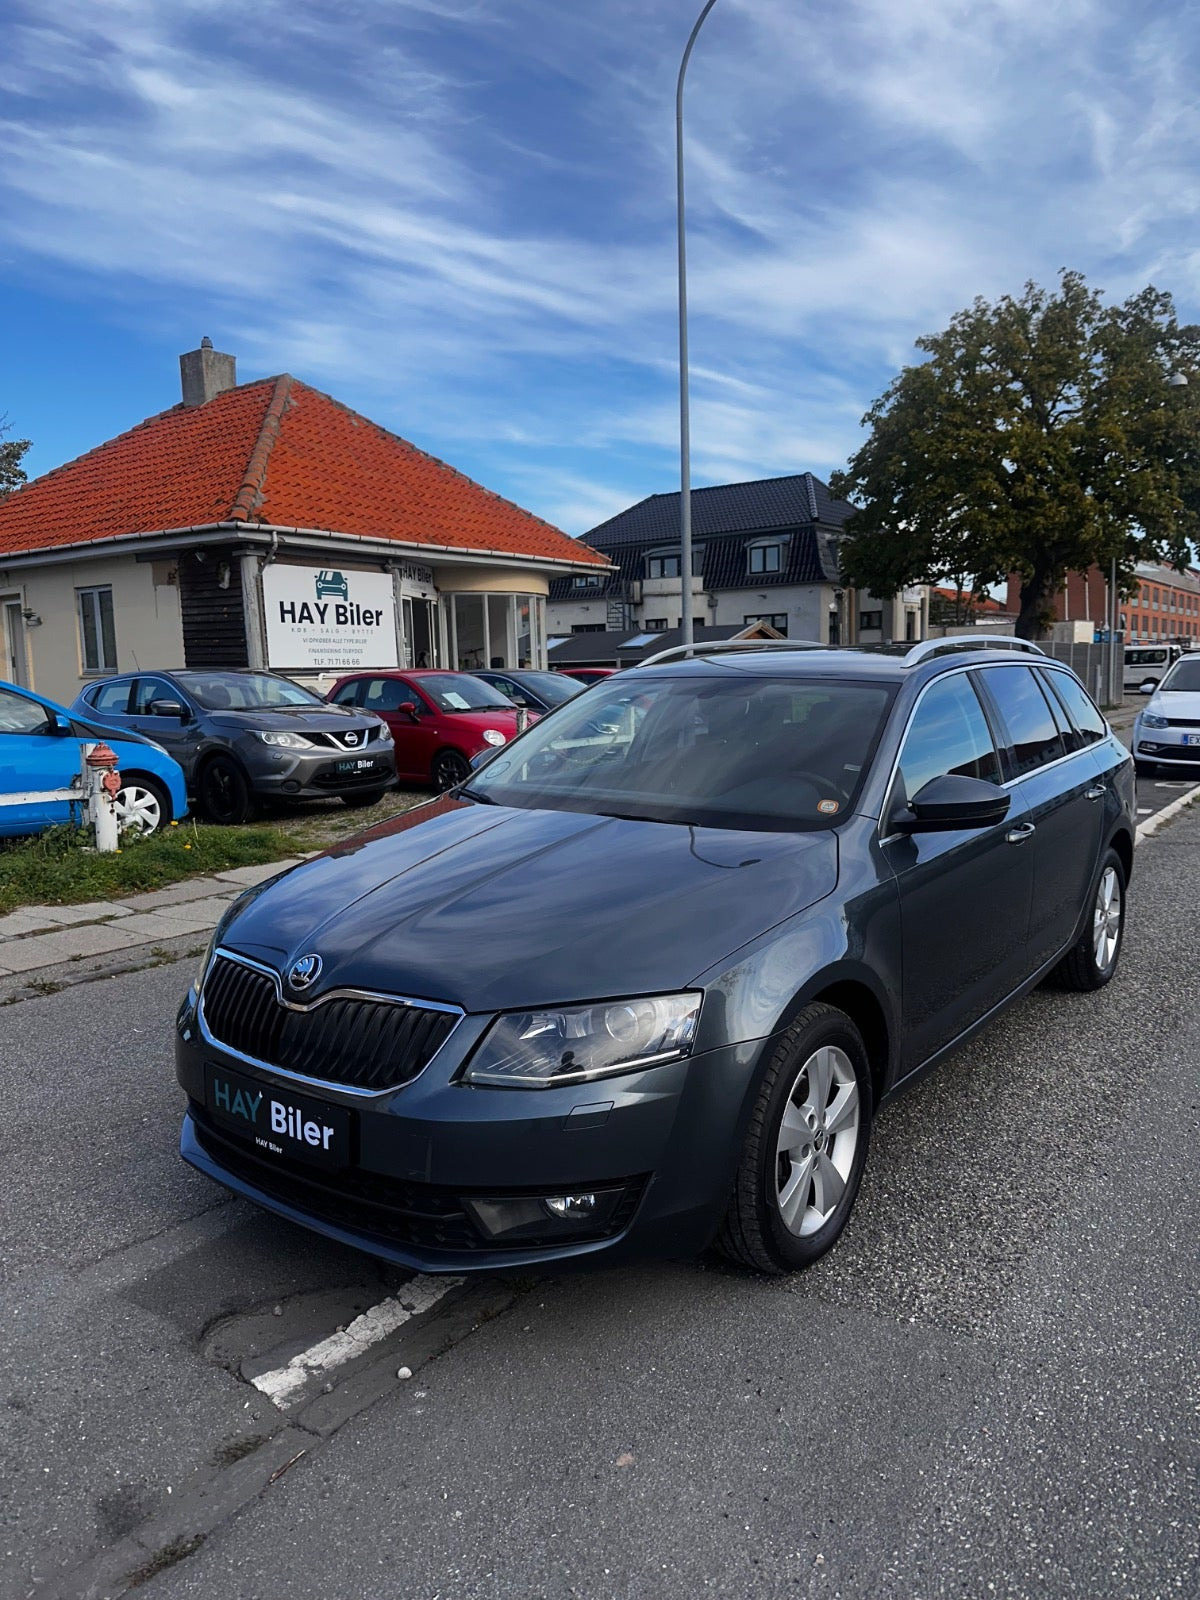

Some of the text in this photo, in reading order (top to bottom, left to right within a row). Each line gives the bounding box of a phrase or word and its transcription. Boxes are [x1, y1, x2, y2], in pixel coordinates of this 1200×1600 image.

[279, 601, 383, 626] HAY Biler
[338, 760, 374, 771] HAY Biler
[214, 1079, 334, 1150] HAY Biler
[255, 1137, 283, 1154] HAY Biler
